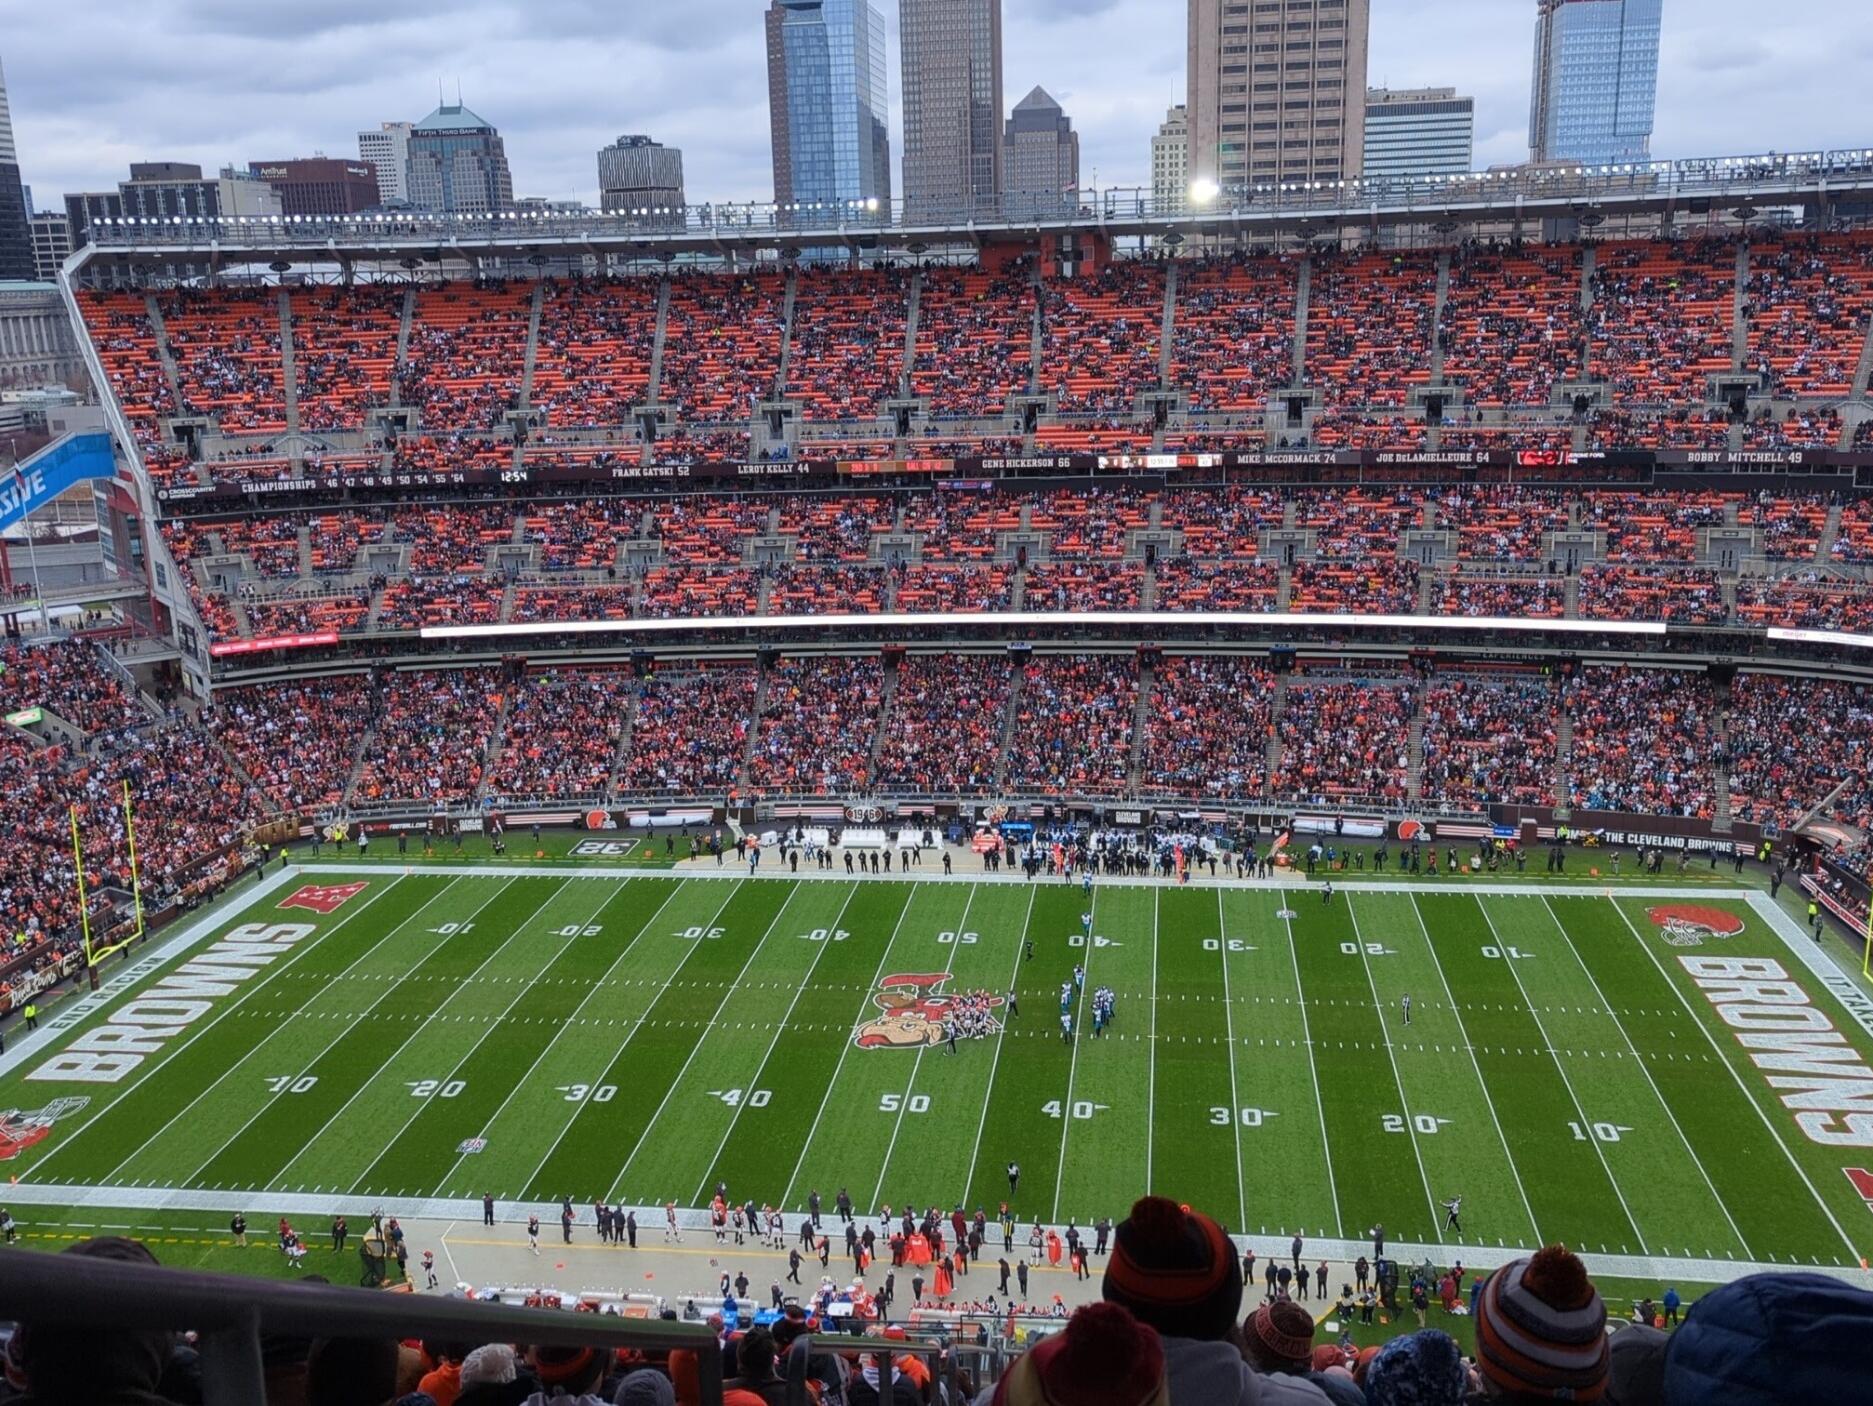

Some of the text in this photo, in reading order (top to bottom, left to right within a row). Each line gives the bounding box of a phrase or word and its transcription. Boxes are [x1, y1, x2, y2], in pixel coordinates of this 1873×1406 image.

[260, 167, 287, 175] AmTrust
[982, 457, 1071, 468] GENE HICKERSON 66
[1237, 454, 1260, 464] MIKE
[1324, 453, 1336, 464] 74
[1376, 453, 1394, 463] JOE
[1476, 452, 1490, 463] 64
[1687, 452, 1803, 463] BOBBY MITCHELL 49
[612, 466, 690, 477] FRANK GATSKI 52
[737, 463, 810, 474] LEROY KELLY 44
[501, 471, 528, 482] 12:54
[241, 479, 317, 493] CHAMPIONSHIPS
[0, 468, 47, 520] SIVE
[1605, 831, 1624, 843] THE
[1627, 832, 1684, 848] CLEVELAND
[46, 955, 167, 1030] END RACISM
[23, 922, 319, 1083] BROWNS
[1823, 976, 1873, 1031] IT TAKE
[1676, 955, 1873, 1147] BROWNS
